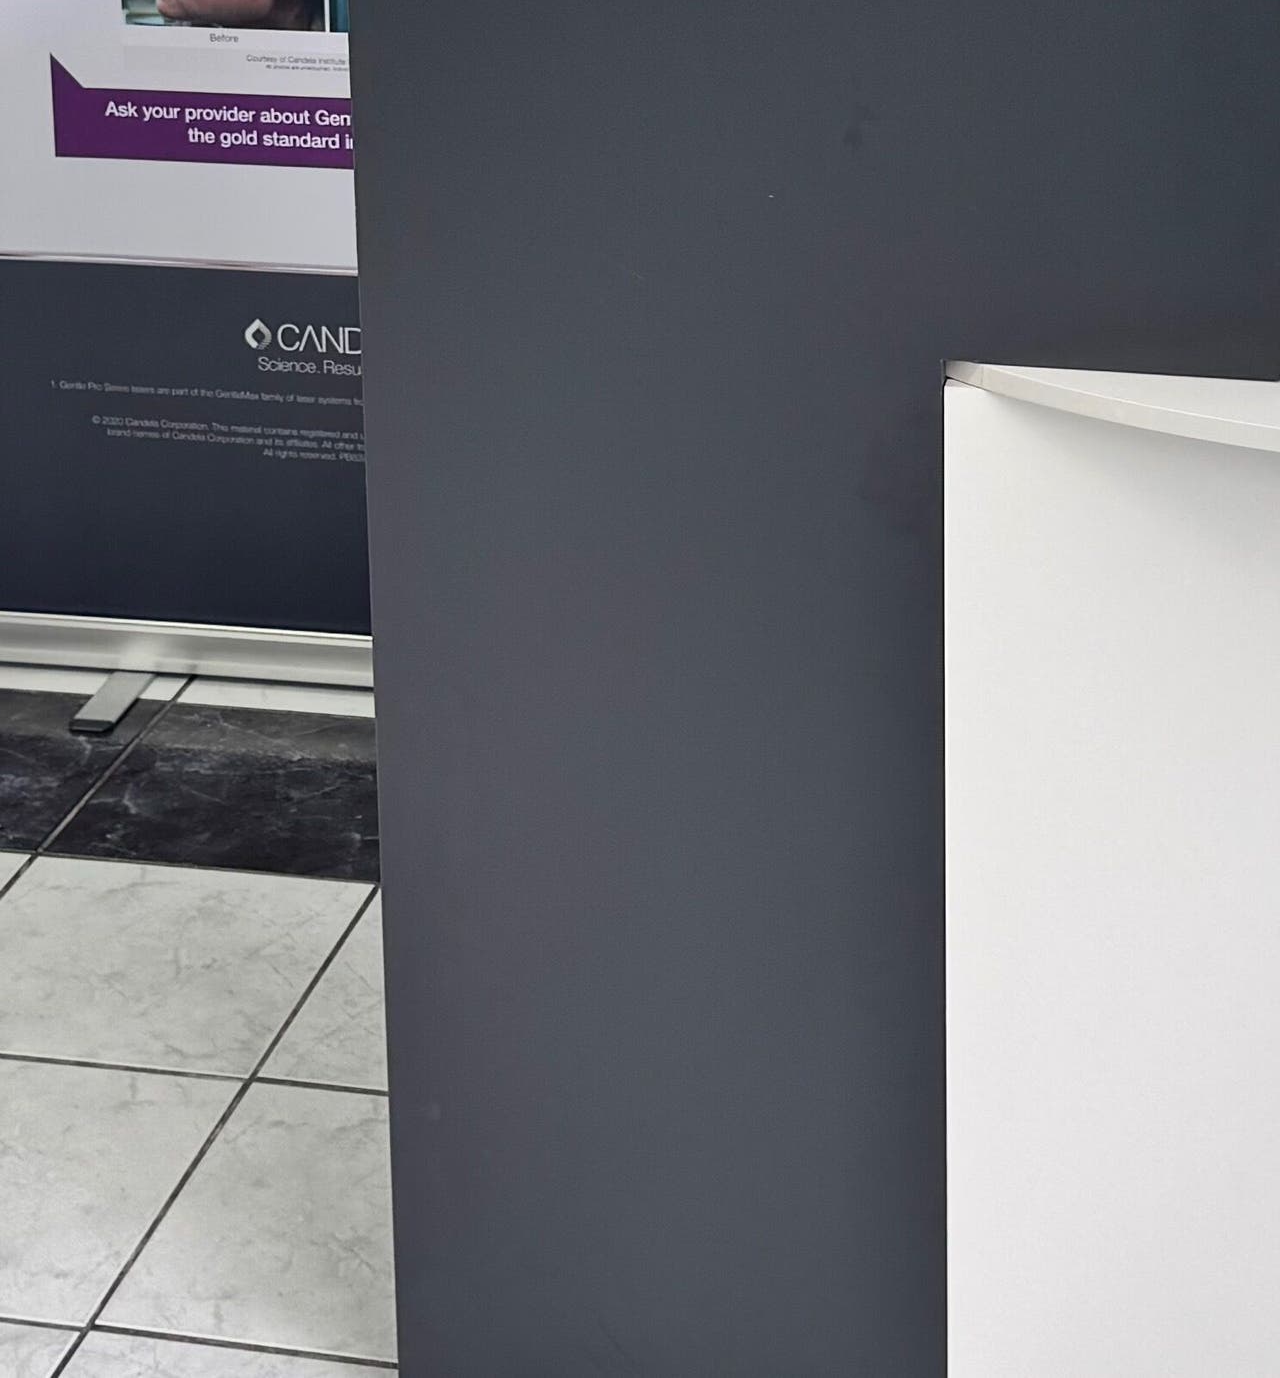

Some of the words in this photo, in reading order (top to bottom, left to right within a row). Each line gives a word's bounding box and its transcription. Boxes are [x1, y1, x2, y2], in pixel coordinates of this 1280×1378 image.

[210, 33, 239, 43] Before
[105, 100, 139, 118] Ask
[142, 107, 181, 123] your
[185, 106, 256, 123] provider
[260, 108, 311, 125] about
[315, 109, 352, 126] Gen
[187, 127, 216, 144] the
[220, 129, 258, 148] gold
[262, 130, 340, 149] standard
[258, 356, 321, 374] Science.
